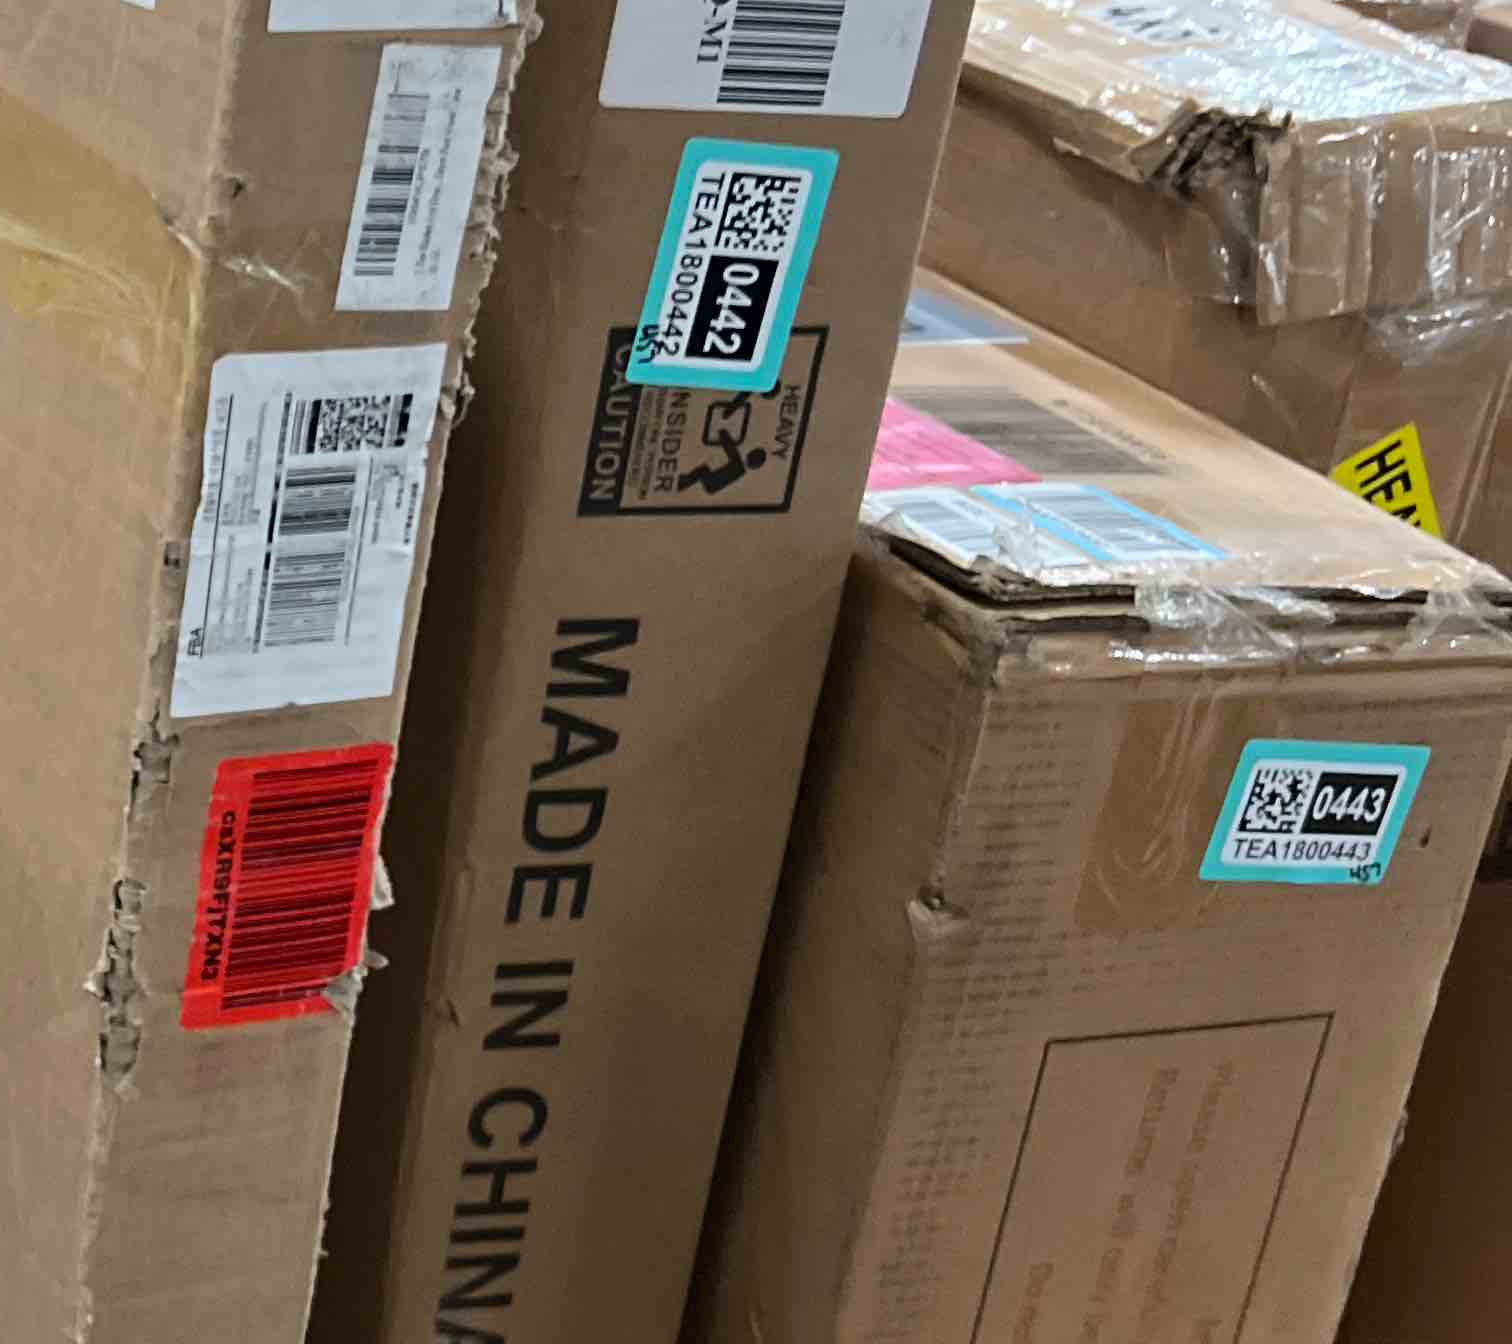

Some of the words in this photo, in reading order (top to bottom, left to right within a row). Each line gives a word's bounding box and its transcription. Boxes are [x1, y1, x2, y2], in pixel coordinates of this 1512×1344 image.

[658, 172, 725, 358] TEA1800442
[702, 261, 760, 356] 0442
[655, 390, 691, 493] NSIDER
[771, 384, 802, 461] HEAVY
[503, 616, 641, 926] MADE
[1312, 784, 1385, 825] 0443
[1232, 836, 1374, 862] TEA1800443
[481, 959, 575, 1051] IN
